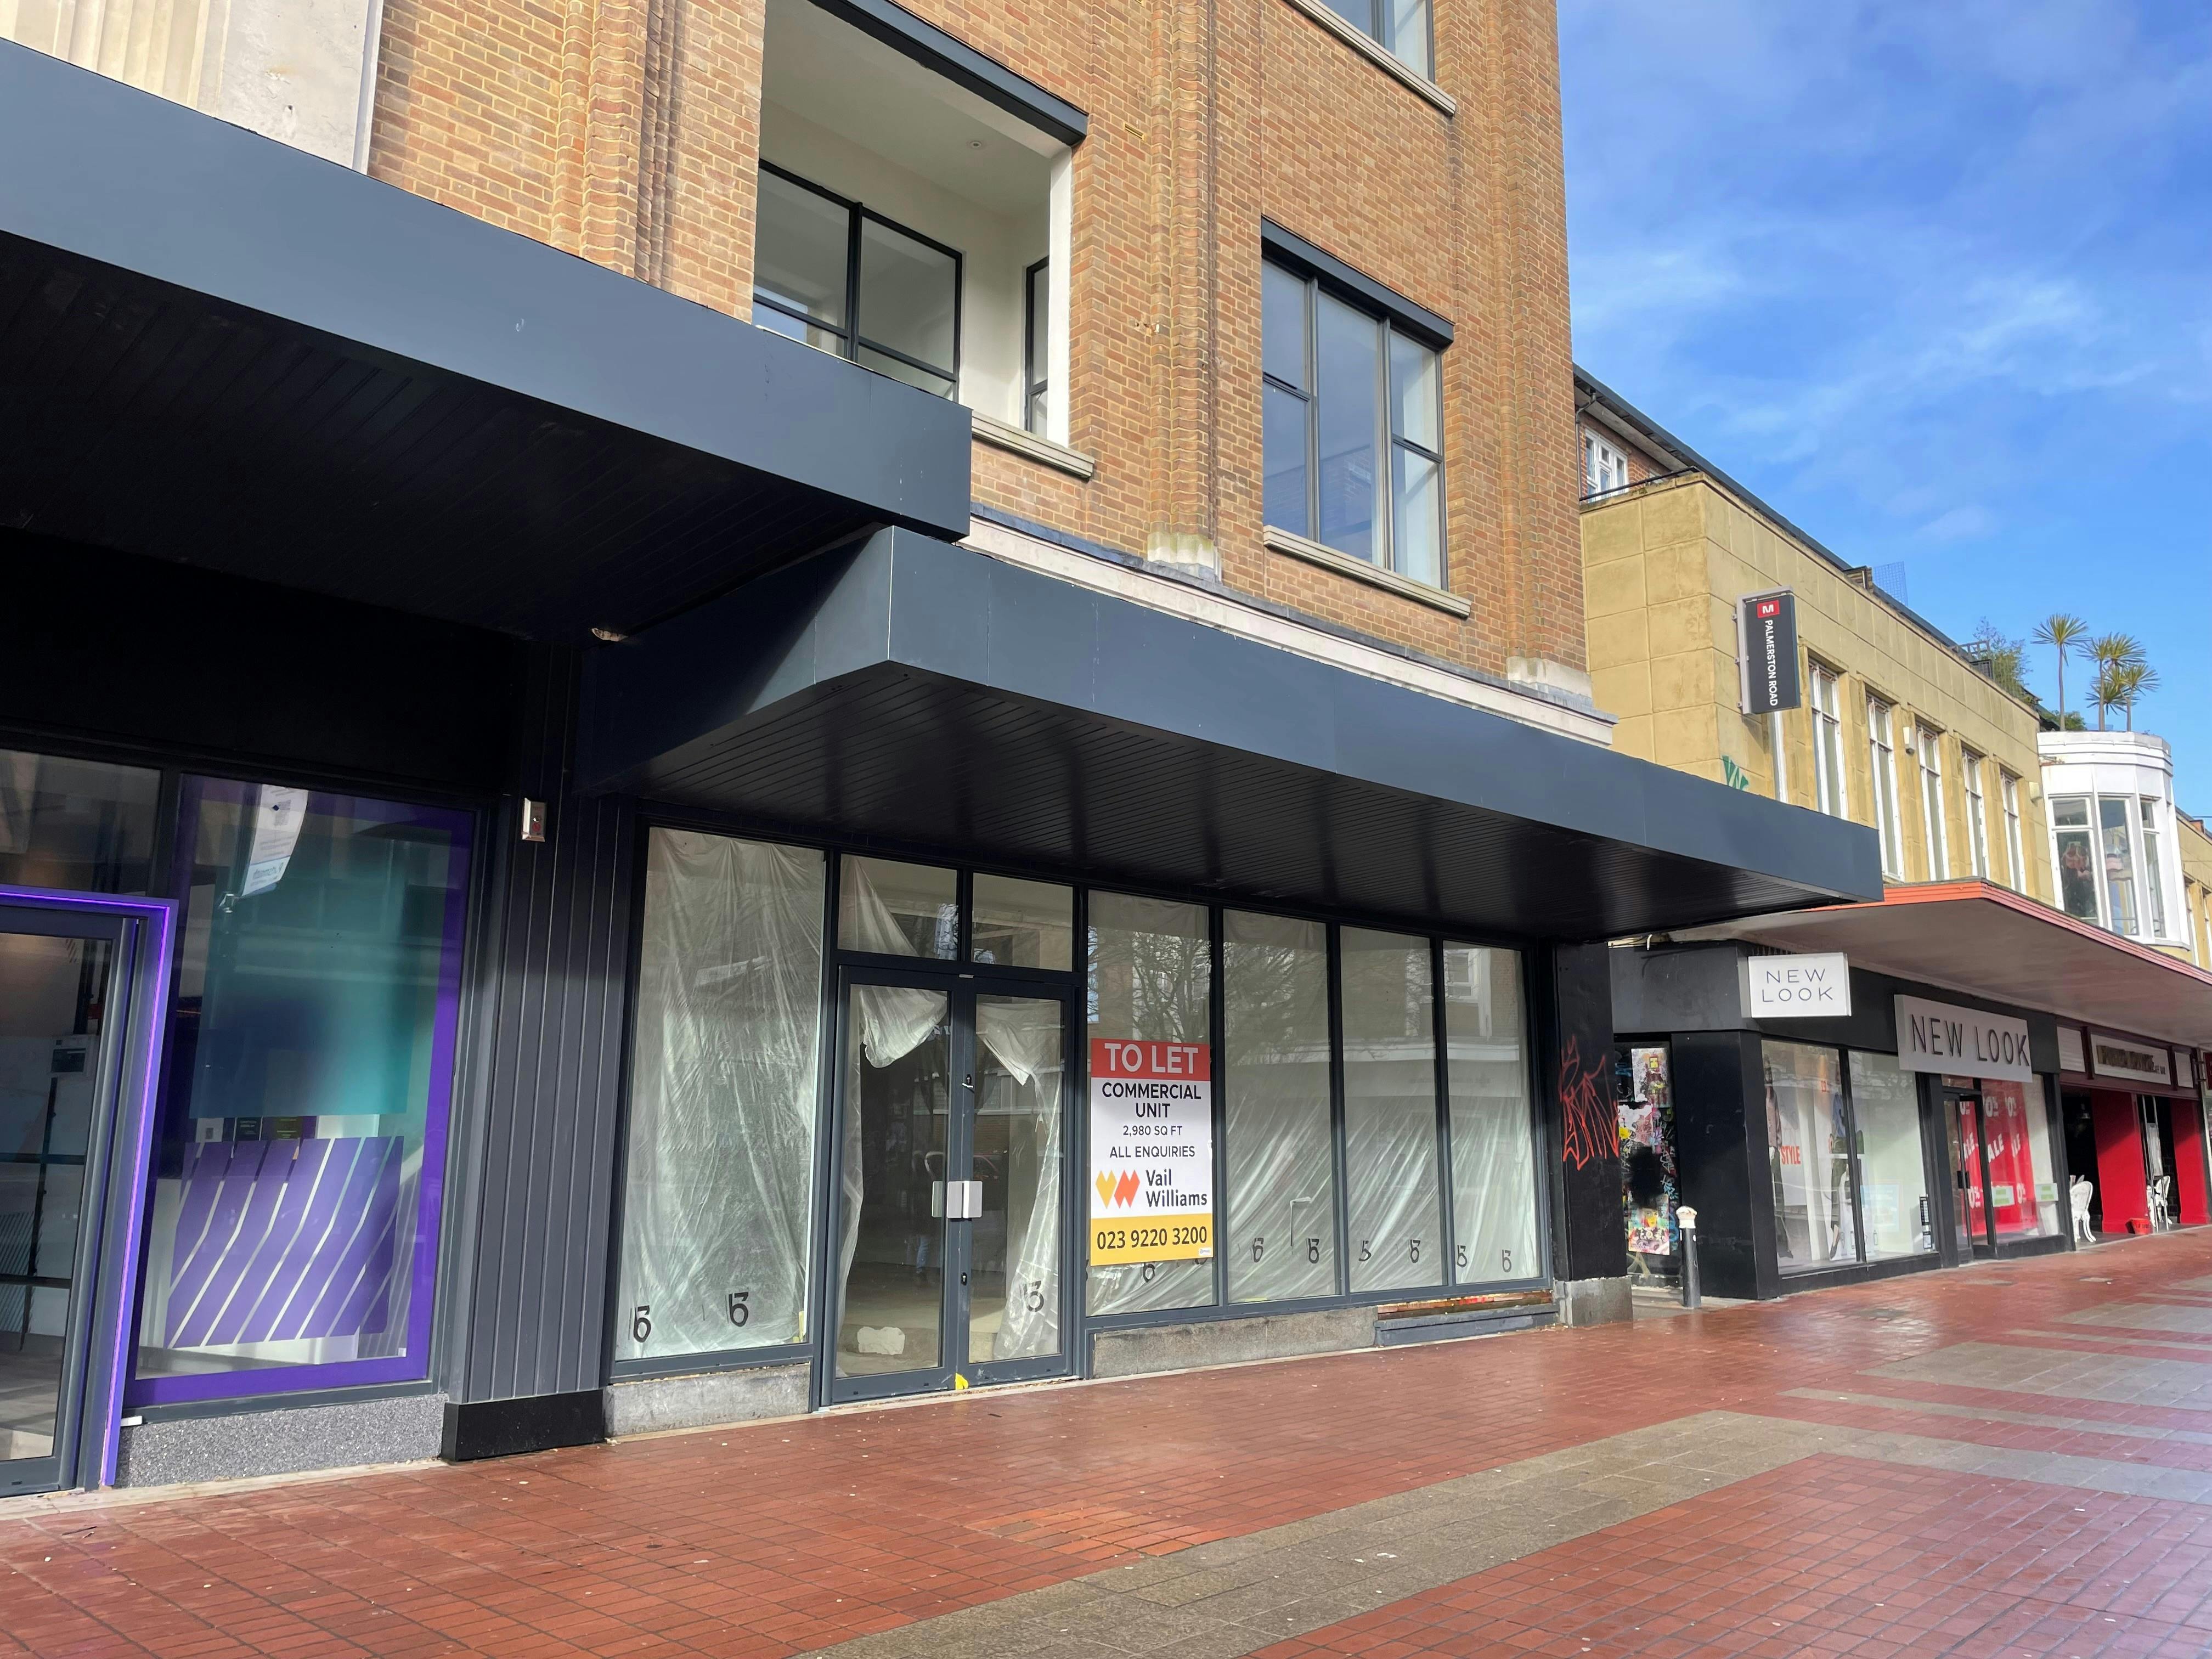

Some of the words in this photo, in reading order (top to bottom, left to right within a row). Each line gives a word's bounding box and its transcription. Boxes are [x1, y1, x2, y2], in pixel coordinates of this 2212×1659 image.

[1762, 603, 1774, 614] M
[1765, 619, 1776, 679] PALMERSTON
[1769, 680, 1779, 707] ROAD
[1767, 968, 1826, 984] NEW
[1762, 987, 1833, 1002] LOOK
[1911, 1013, 1962, 1058] NEW
[1975, 1025, 2030, 1066] LOOK
[1104, 1042, 1143, 1073] TO
[1152, 1045, 1199, 1074] LET
[1102, 1081, 1201, 1100] COMMERCIAL
[1136, 1102, 1171, 1118] UNIT
[1122, 1125, 1152, 1137] 2,980
[1154, 1125, 1168, 1136] SQ
[1171, 1125, 1183, 1136] FT
[1109, 1146, 1131, 1158] ALL
[1135, 1146, 1195, 1158] ENQUIRIES
[1781, 1146, 1801, 1165] STYLE
[1987, 1133, 2005, 1164] ALE
[1146, 1169, 1172, 1186] Vail
[1146, 1189, 1207, 1207] Williams
[1097, 1230, 1126, 1250] 023
[1130, 1228, 1167, 1248] 9220
[1172, 1226, 1207, 1245] 3200
